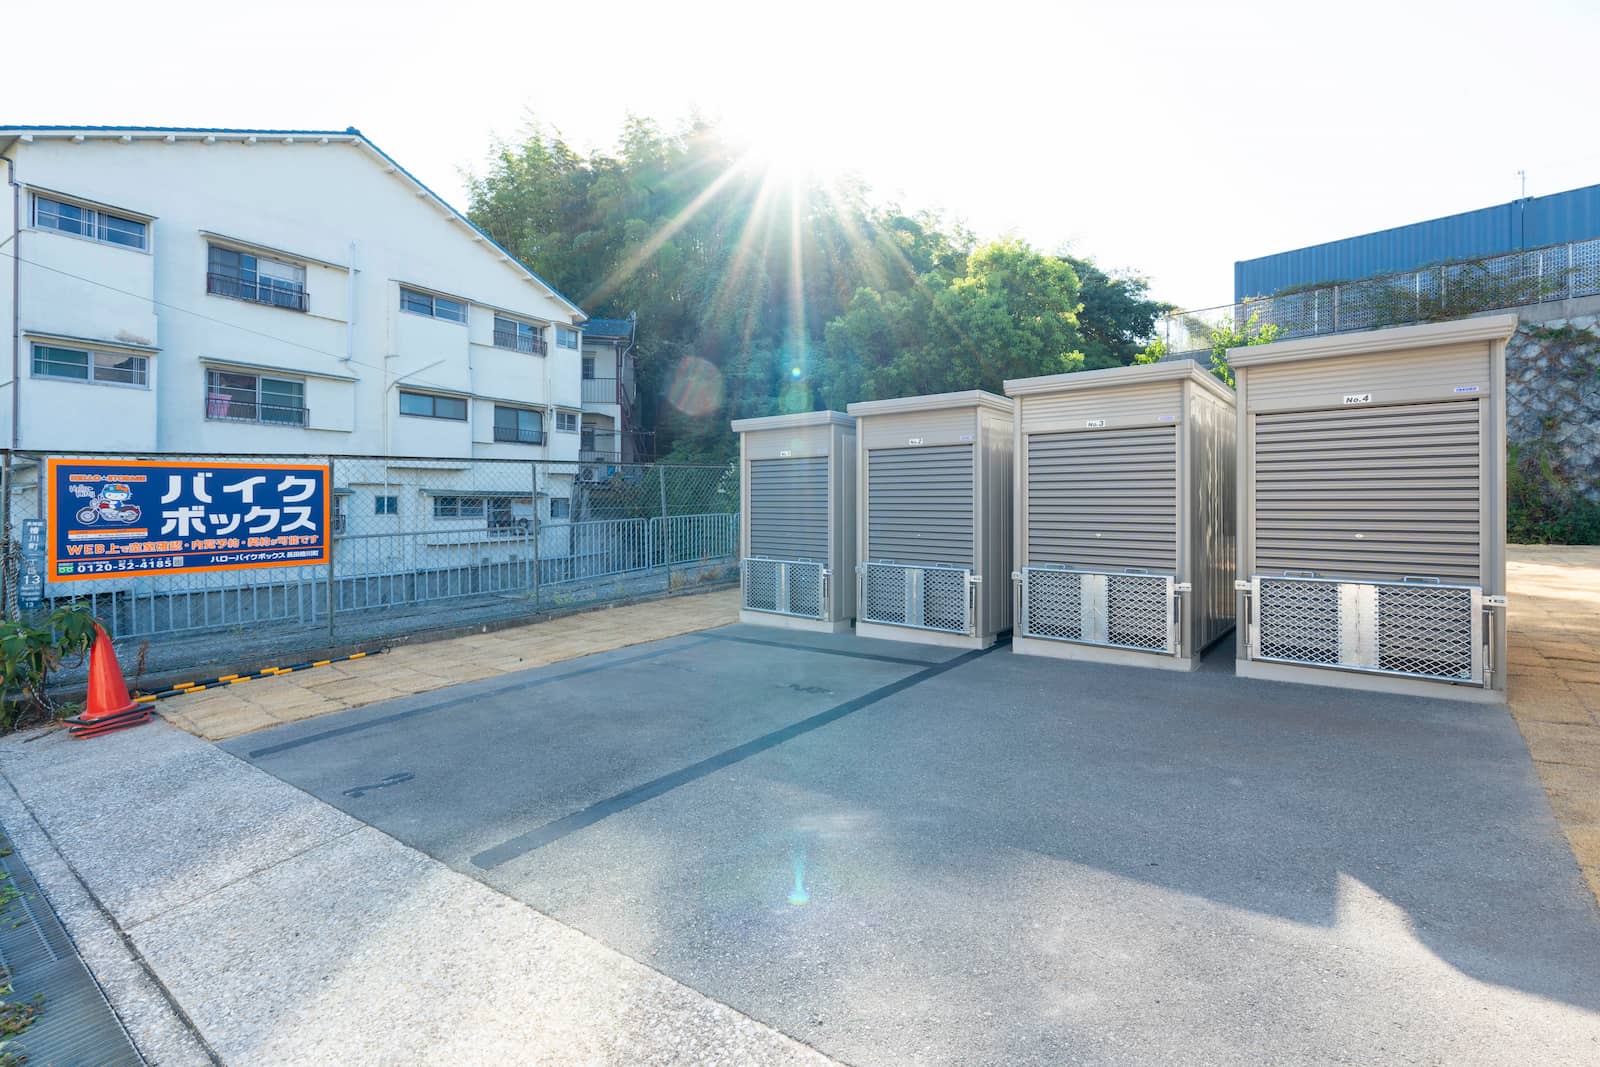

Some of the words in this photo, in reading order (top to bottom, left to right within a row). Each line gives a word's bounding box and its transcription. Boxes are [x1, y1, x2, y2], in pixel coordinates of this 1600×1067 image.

[1346, 394, 1369, 403] No.4
[161, 472, 316, 504] バイク
[161, 505, 317, 537] ボックス
[77, 559, 172, 573] 0120-52-4185
[24, 575, 41, 585] 13
